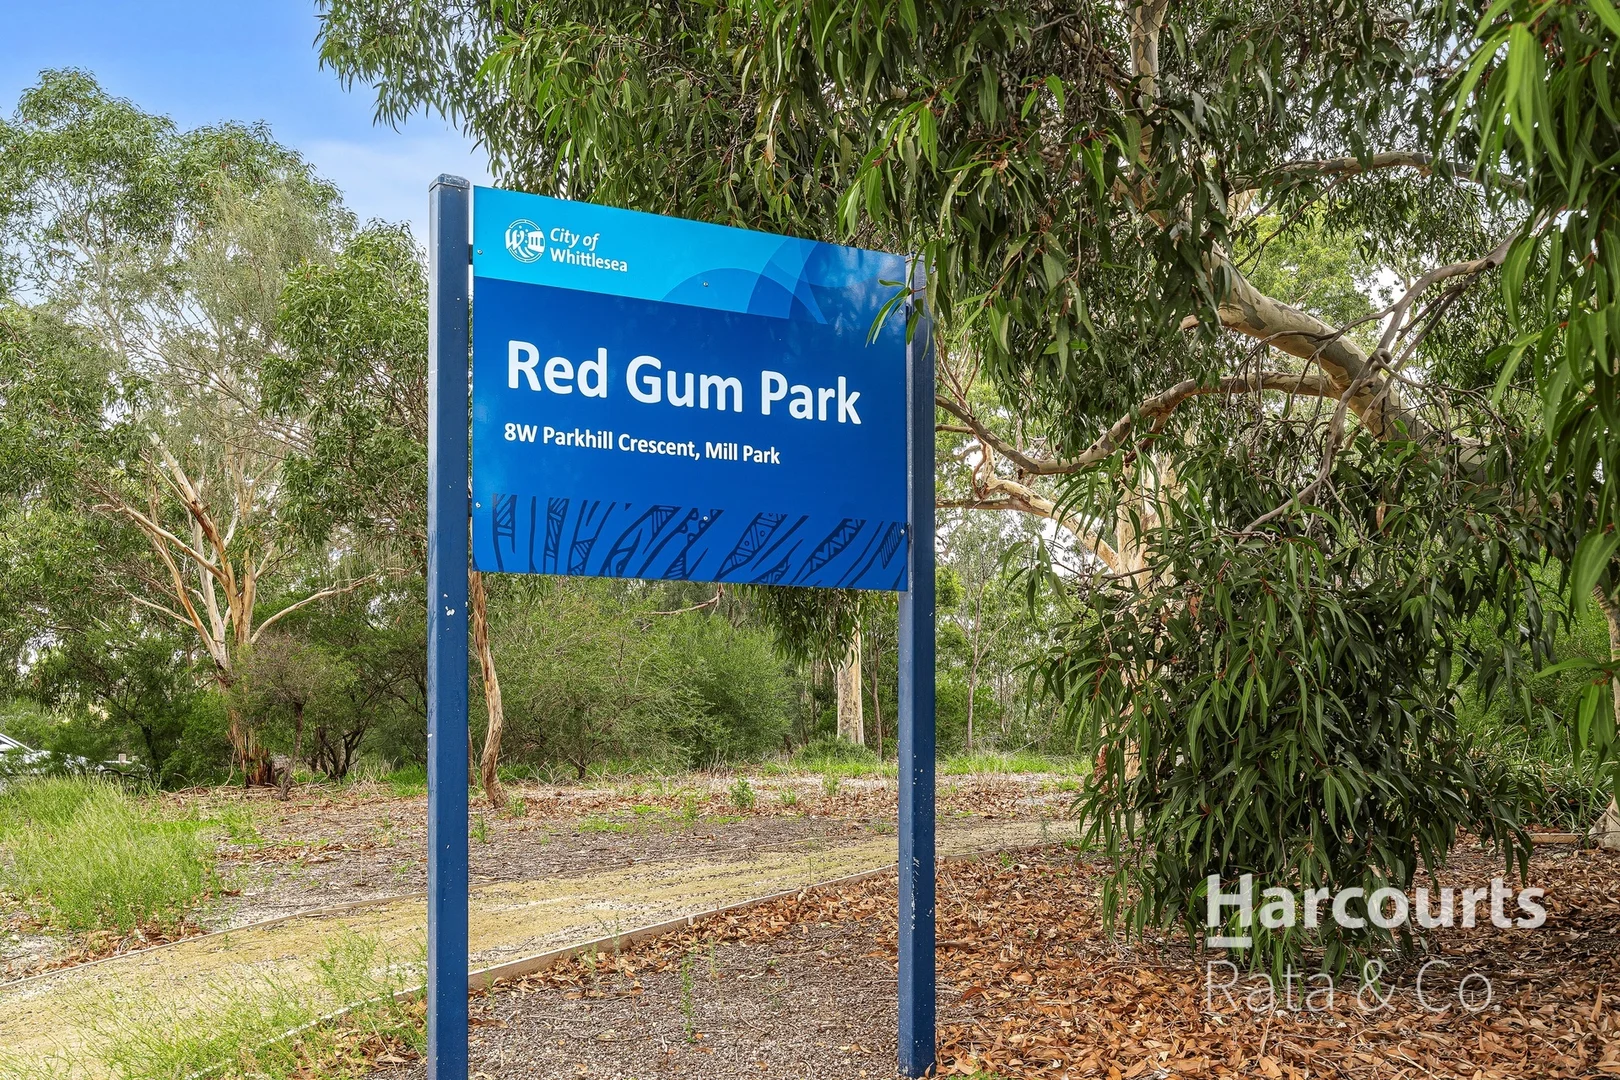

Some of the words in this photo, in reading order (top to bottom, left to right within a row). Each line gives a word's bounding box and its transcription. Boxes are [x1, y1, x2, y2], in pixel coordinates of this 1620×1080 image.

[550, 227, 580, 248] City
[582, 233, 600, 251] of
[550, 247, 628, 272] Whittlesea
[507, 340, 608, 399] Red
[625, 355, 743, 413] Gum
[760, 370, 862, 425] Park
[504, 422, 538, 443] 8W
[543, 426, 613, 450] Parkhill
[618, 433, 700, 461] Crescent,
[705, 441, 738, 461] Mill
[743, 445, 780, 465] Park
